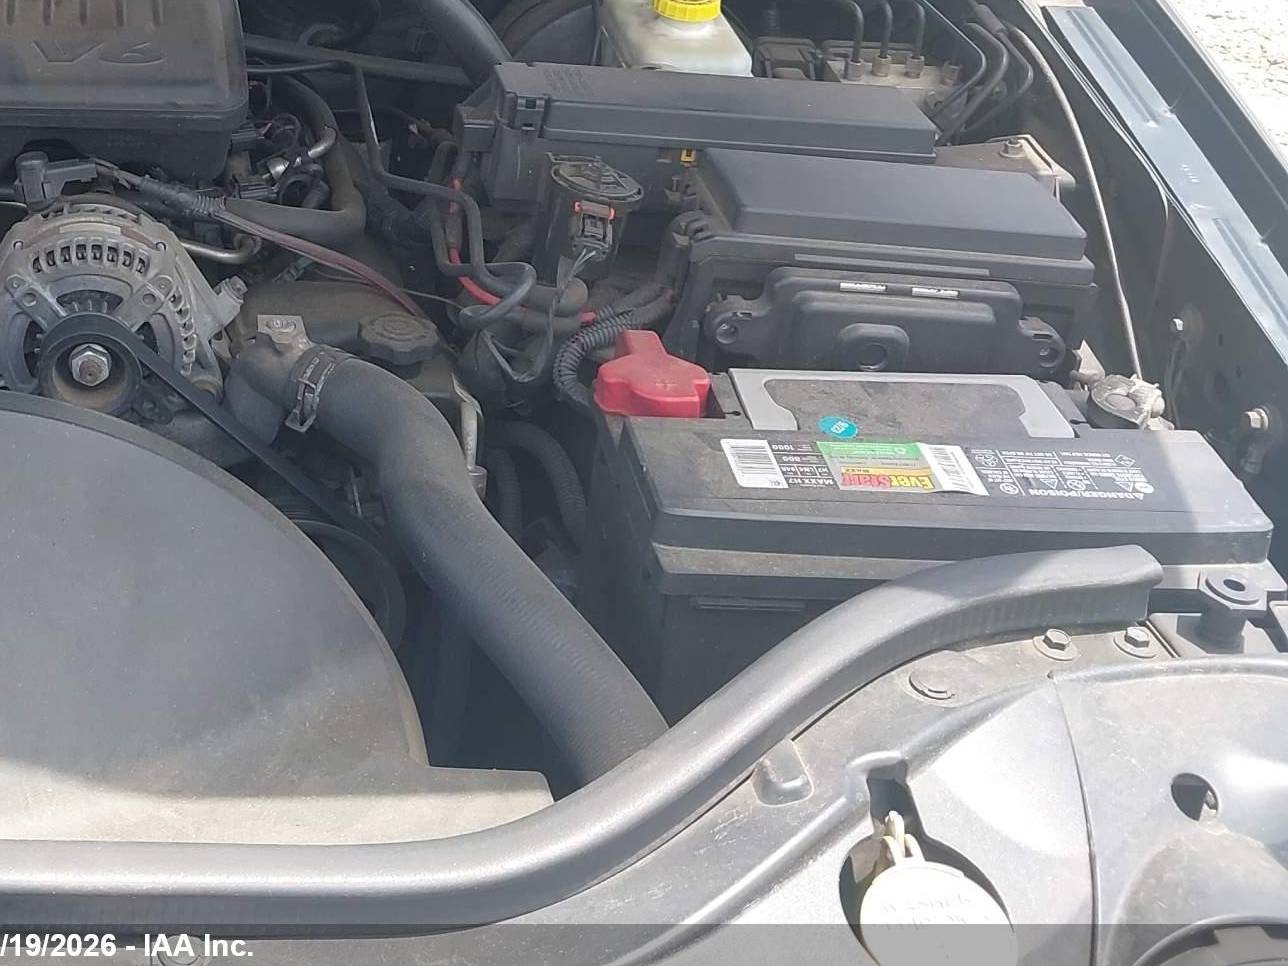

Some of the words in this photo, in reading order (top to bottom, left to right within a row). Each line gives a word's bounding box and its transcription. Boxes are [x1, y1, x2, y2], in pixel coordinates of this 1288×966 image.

[32, 40, 168, 66] V6
[803, 478, 834, 486] MAXX
[842, 473, 935, 490] EverStart
